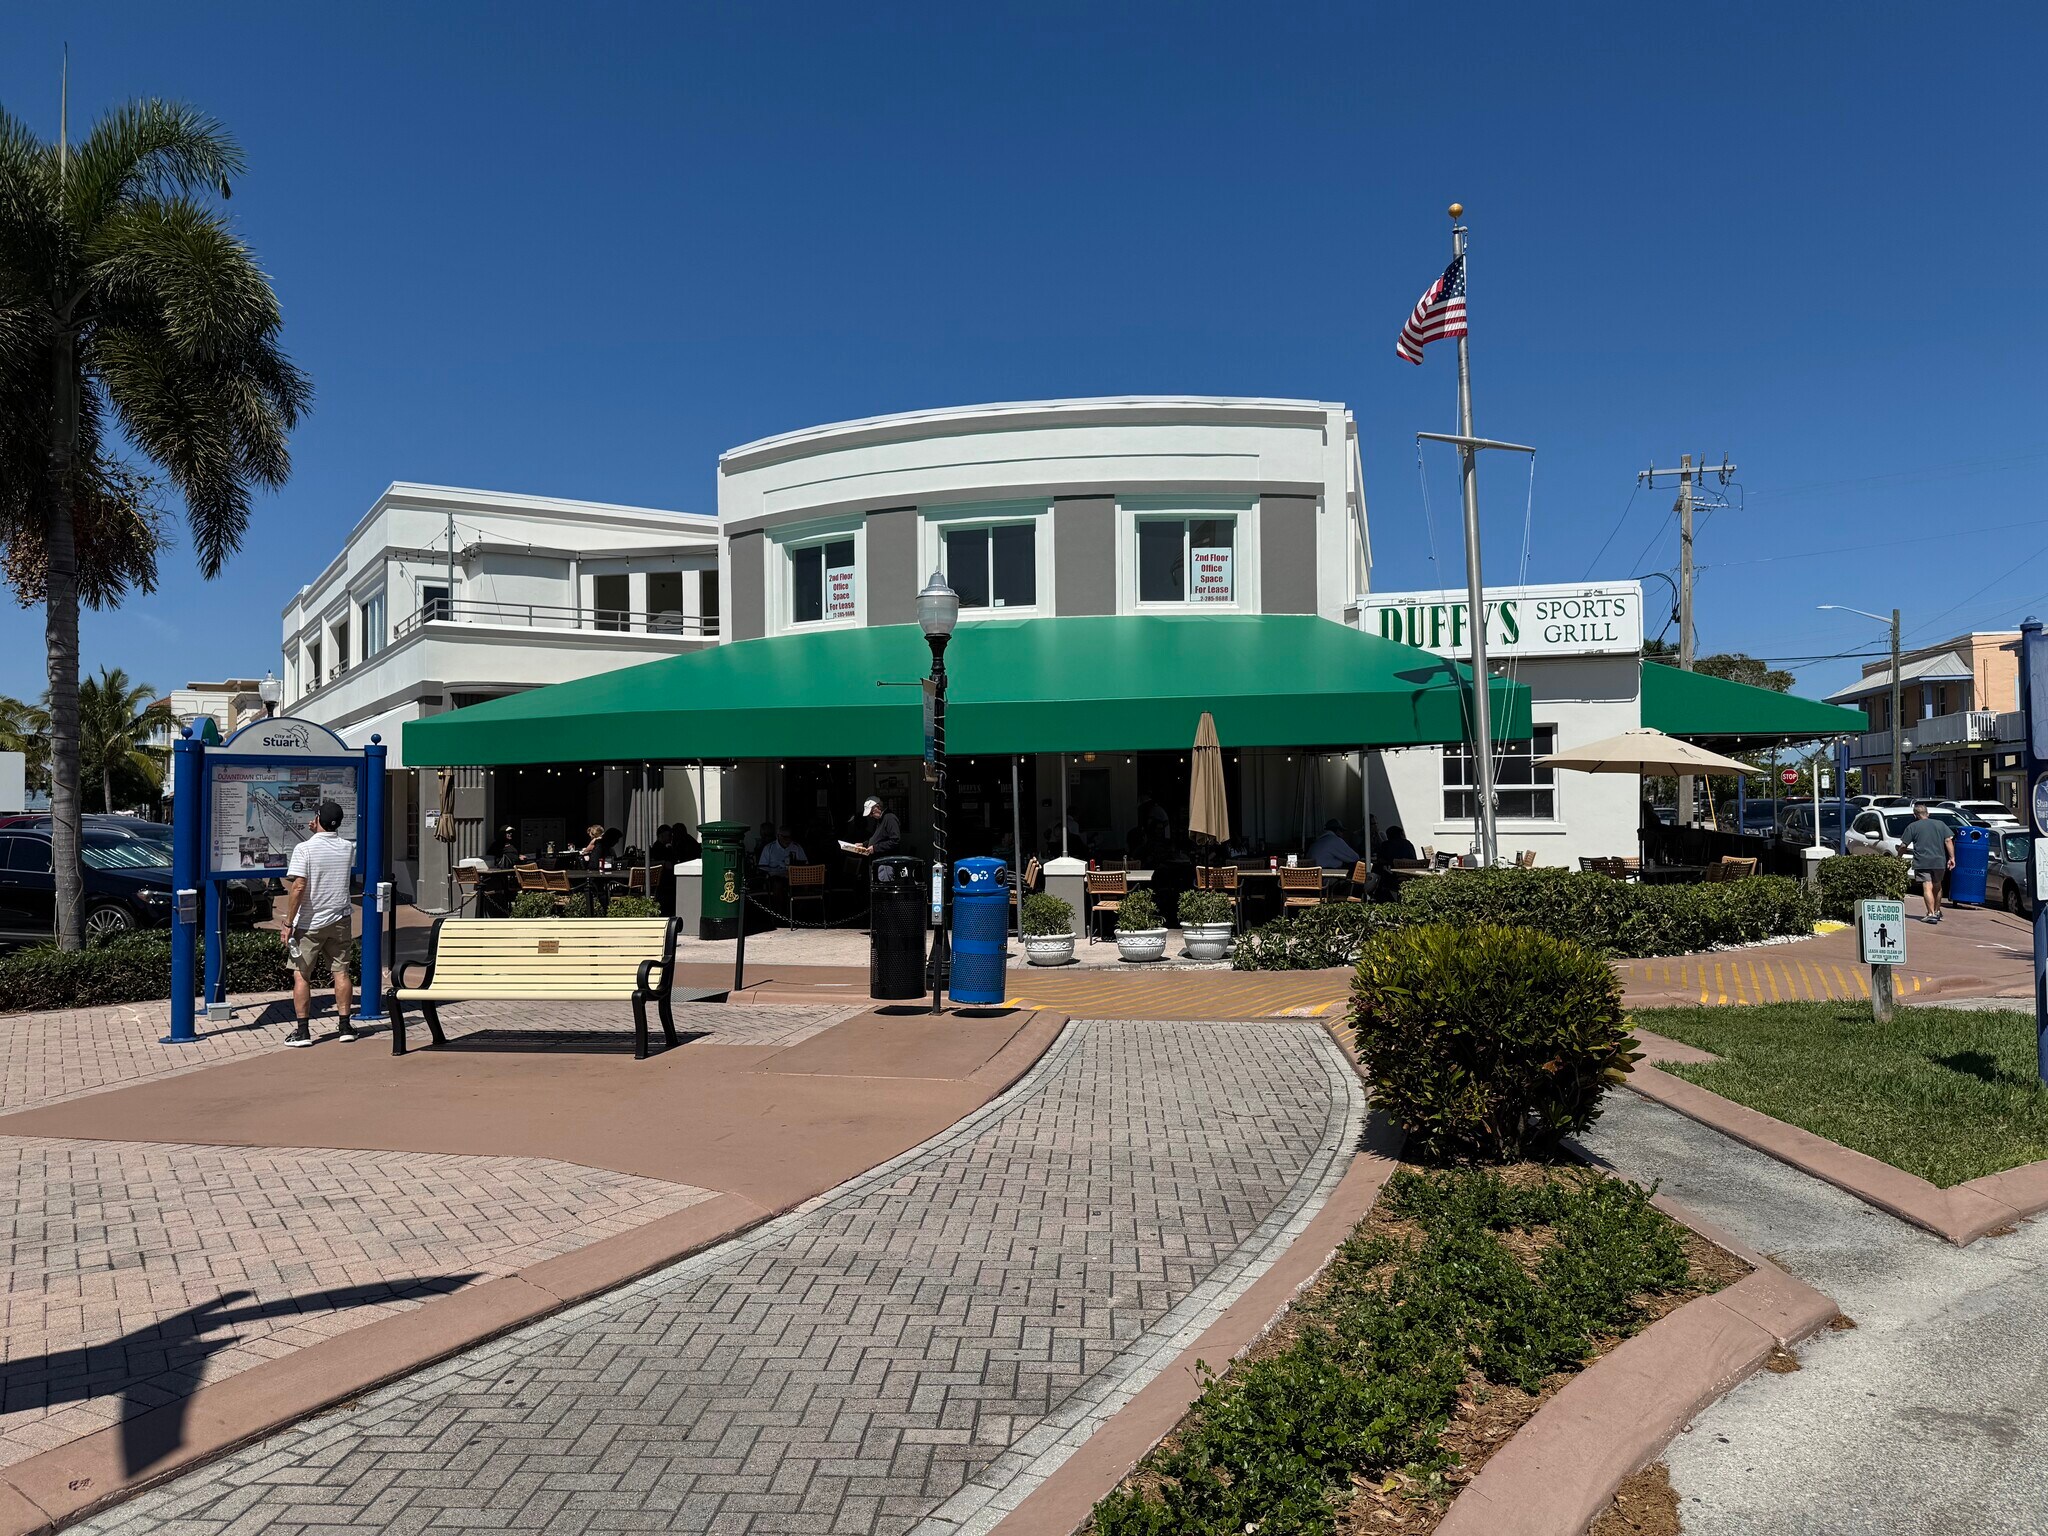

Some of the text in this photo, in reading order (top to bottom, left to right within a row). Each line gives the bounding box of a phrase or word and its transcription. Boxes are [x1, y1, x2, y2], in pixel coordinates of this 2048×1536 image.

[1201, 564, 1222, 572] Office
[829, 574, 838, 582] 2nd
[1201, 575, 1223, 583] Space
[833, 583, 849, 591] Office
[833, 593, 850, 601] Space
[830, 603, 838, 611] For
[1536, 598, 1625, 620] SPORTS
[1544, 623, 1618, 643] GRILL
[263, 737, 300, 747] Stuart
[1868, 913, 1899, 921] NEIGHBOR
